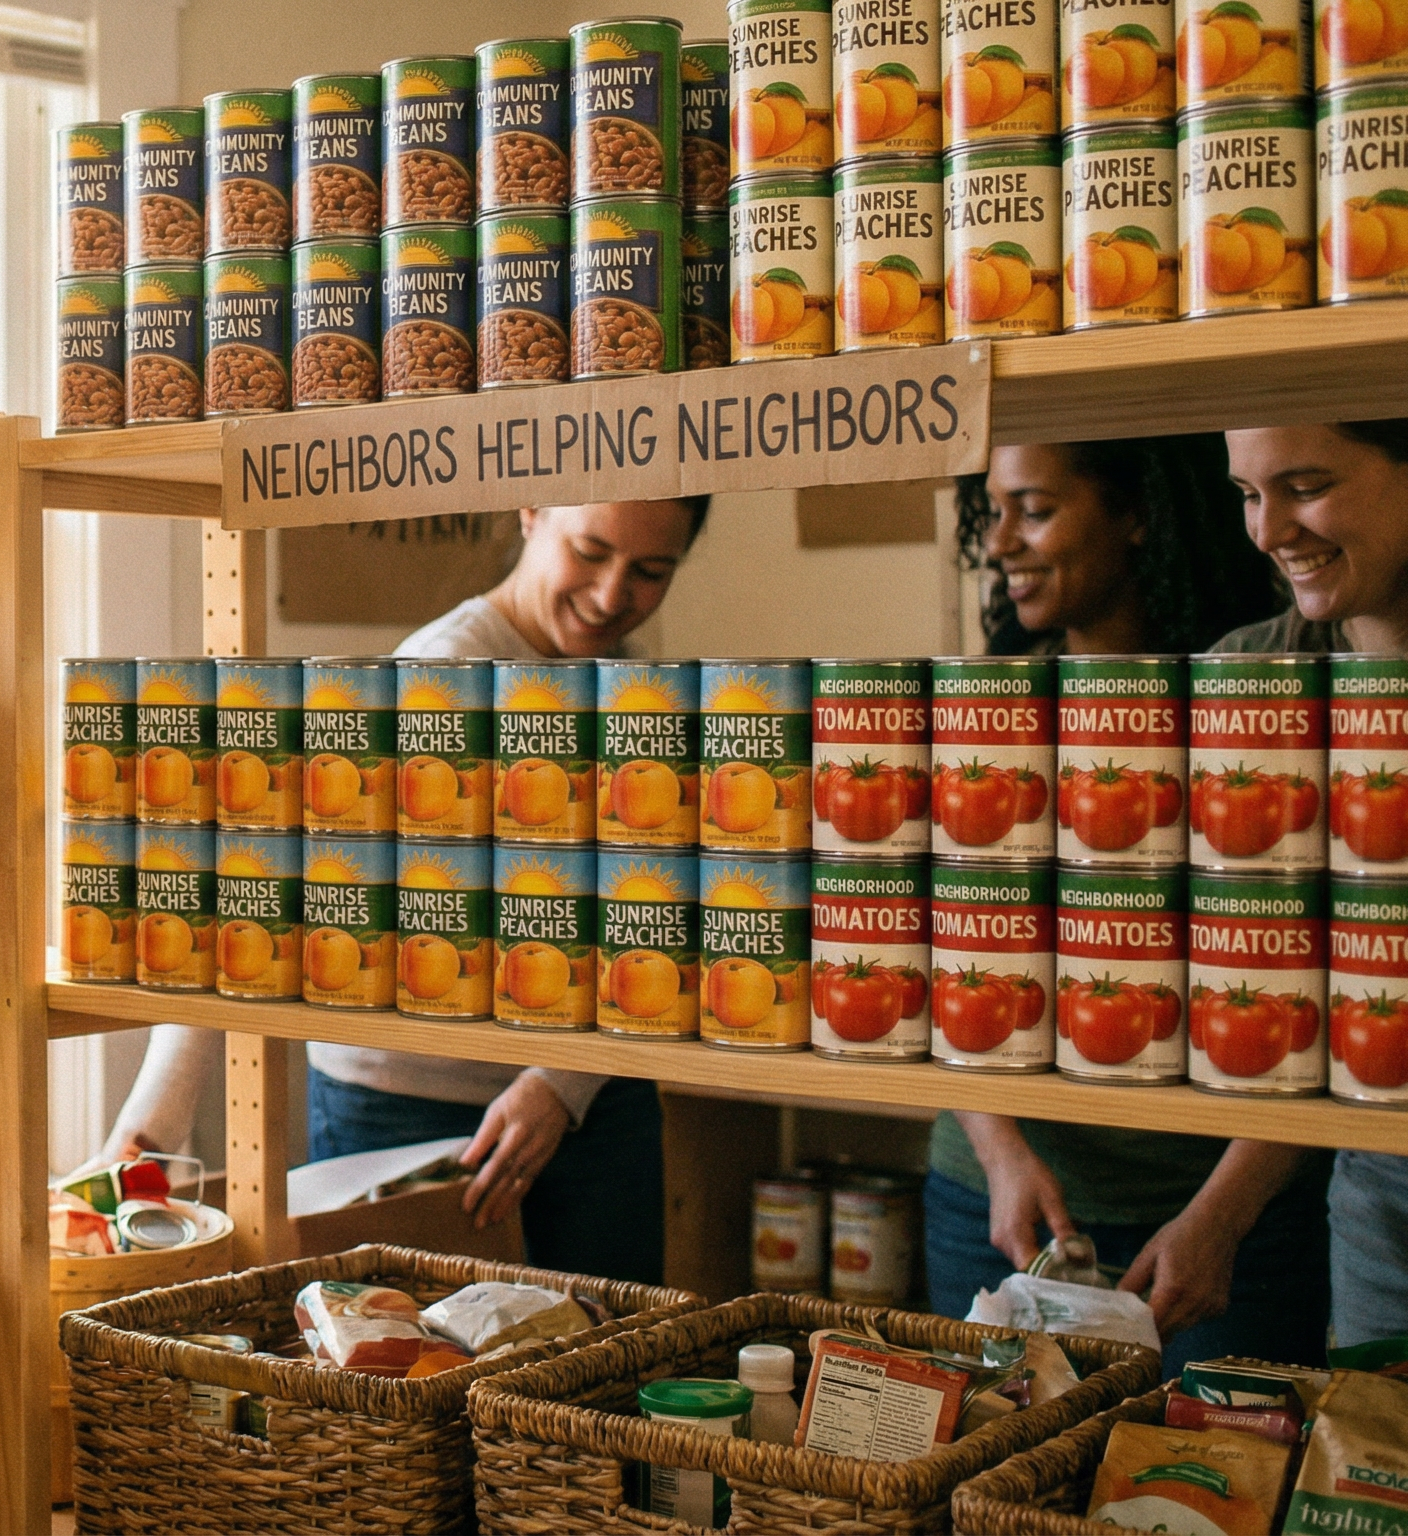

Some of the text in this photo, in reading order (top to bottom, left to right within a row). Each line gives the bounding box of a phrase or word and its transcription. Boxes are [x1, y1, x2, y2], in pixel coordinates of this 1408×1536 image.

[732, 17, 800, 44] SUNRISE
[832, 20, 929, 56] PEACHES
[1327, 114, 1408, 143] SUNRIS
[1191, 136, 1281, 163] SUNRISE
[1072, 156, 1155, 182] SUNRISE
[1182, 160, 1298, 200] PEACHES
[950, 173, 1027, 201] SUNRISE
[1064, 180, 1173, 217] PEACHES
[841, 189, 918, 214] SUNRISE
[483, 281, 543, 306] BEANS
[574, 269, 634, 295] BEANS
[390, 293, 449, 316] BEANS
[209, 318, 262, 340] BEANS
[297, 307, 355, 330] BEANS
[243, 425, 458, 502] NEIGHBORS
[478, 406, 658, 482] HELPING
[397, 713, 465, 732] SUNRISE
[499, 715, 577, 734] SUNRISE
[606, 715, 686, 736] SUNRISE
[704, 716, 784, 737] SUNRISE
[816, 706, 926, 732] TOMATOES
[932, 707, 1039, 732] TOMATOES
[1060, 708, 1175, 733] TOMATOES
[1190, 709, 1310, 736] TOMATOES
[1330, 709, 1408, 735] TOMAT
[397, 733, 466, 752] PEACHES
[499, 735, 578, 755] PEACHES
[605, 736, 688, 756] PEACHES
[704, 738, 785, 760] PEACHES
[398, 890, 468, 911] SUNRISE
[500, 897, 577, 918] SUNRISE
[398, 911, 468, 933] PEACHES
[606, 904, 688, 926] SUNRISE
[704, 908, 784, 933] SUNRISE
[813, 904, 921, 931] TOMATOES
[932, 910, 1038, 940] TOMATOES
[499, 917, 578, 939] PEACHES
[605, 924, 688, 947] PEACHES
[1058, 917, 1173, 947] TOMATOES
[1190, 924, 1312, 955] TOMATOES
[703, 931, 785, 955] PEACHES
[1330, 930, 1408, 962] TOMAT
